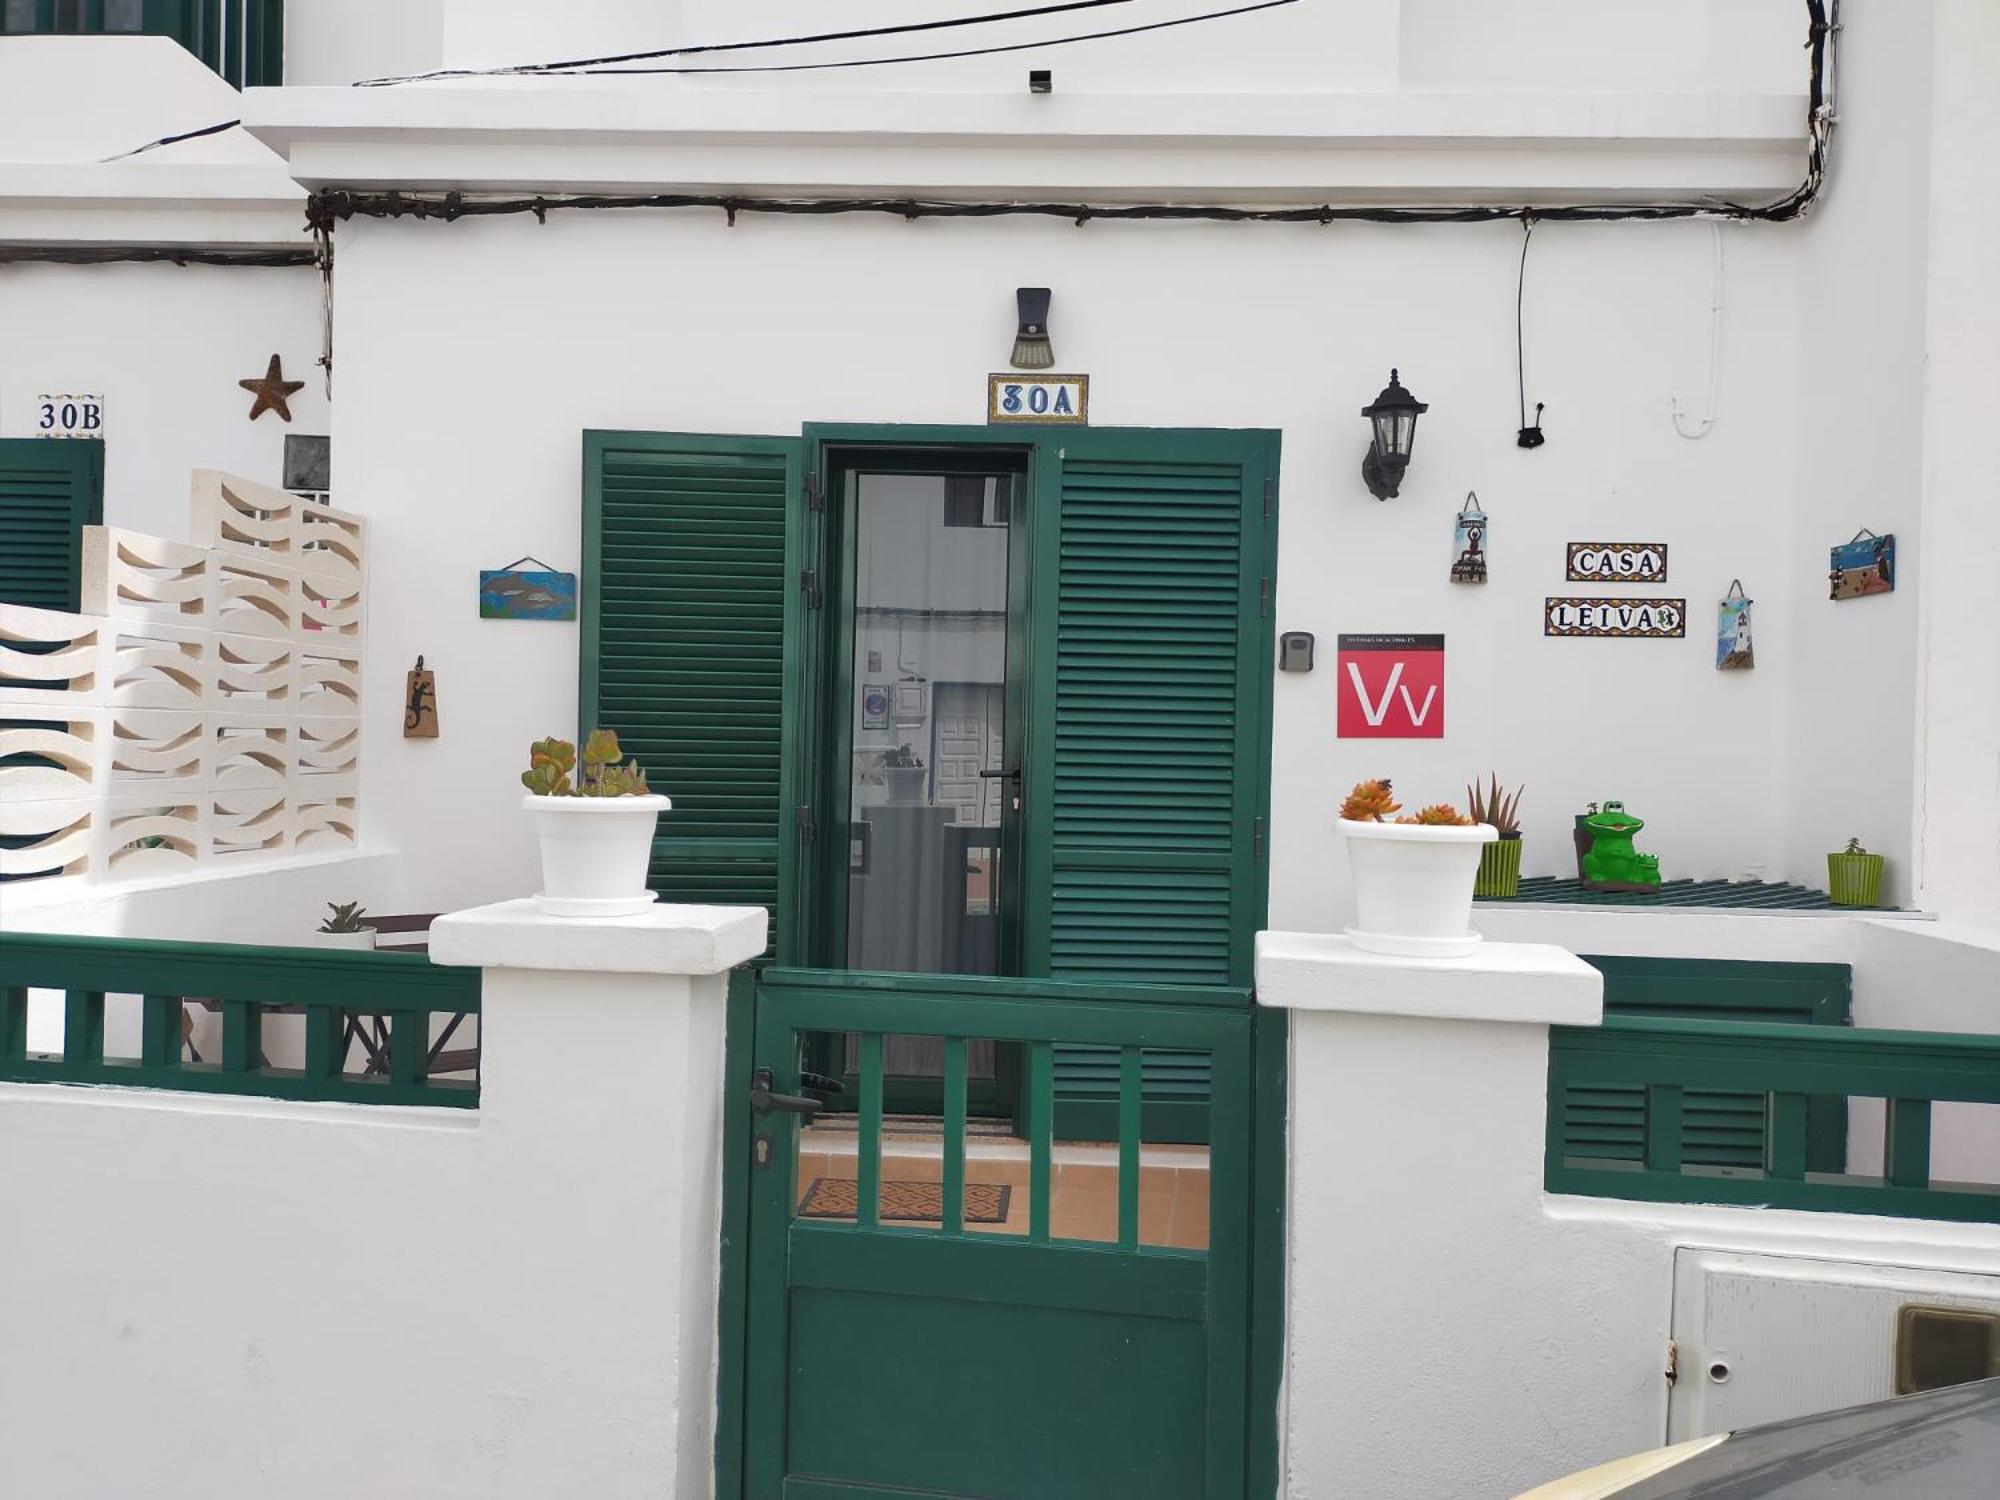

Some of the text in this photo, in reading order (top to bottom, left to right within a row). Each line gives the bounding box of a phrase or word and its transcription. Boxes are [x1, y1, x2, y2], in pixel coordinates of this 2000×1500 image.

[1002, 384, 1073, 414] 30A
[40, 403, 101, 430] 30B
[1579, 552, 1655, 573] CASA
[1558, 607, 1653, 628] LEIVA
